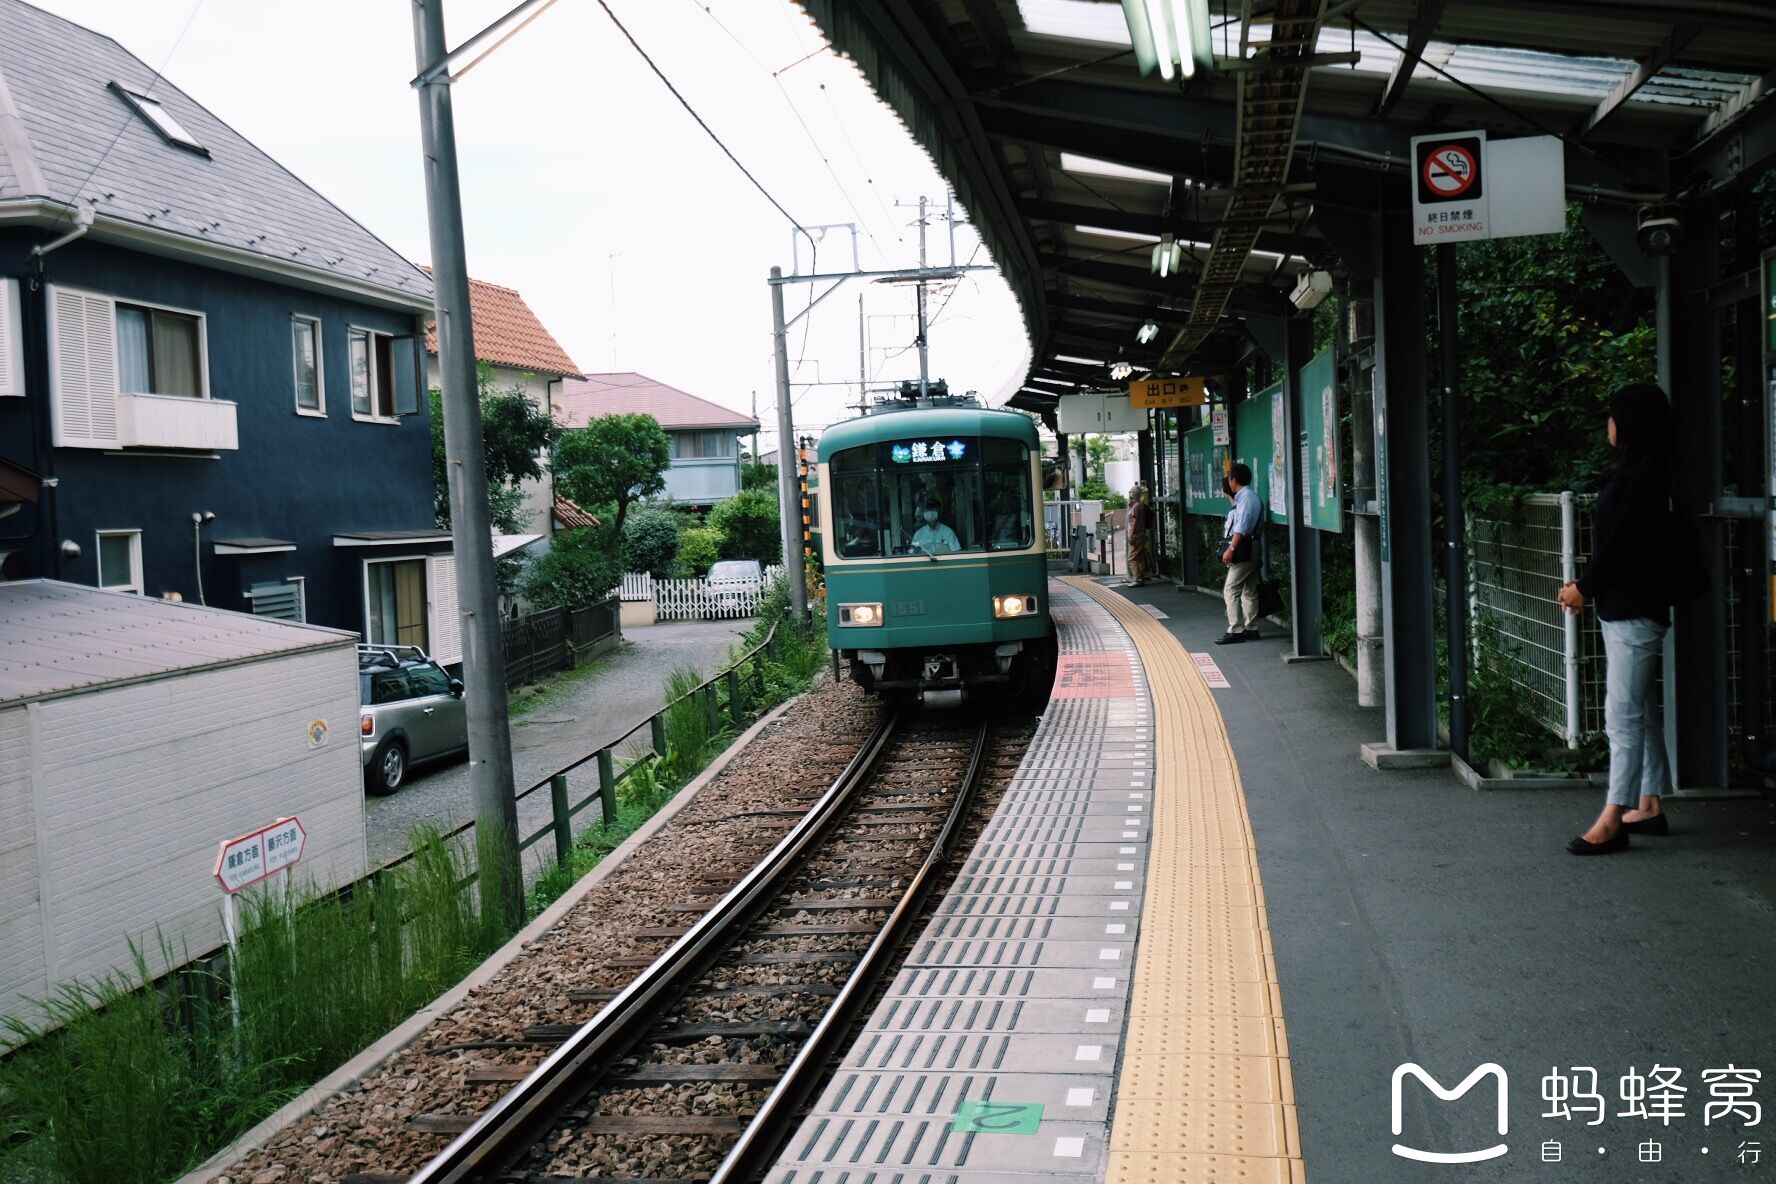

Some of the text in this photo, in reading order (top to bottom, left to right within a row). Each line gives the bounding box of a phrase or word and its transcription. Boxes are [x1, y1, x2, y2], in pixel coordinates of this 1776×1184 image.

[1428, 209, 1473, 223] 終日禁煙
[1419, 223, 1483, 236] NO SMOKING
[1147, 383, 1176, 397] 出口
[911, 441, 946, 458] 鎌倉
